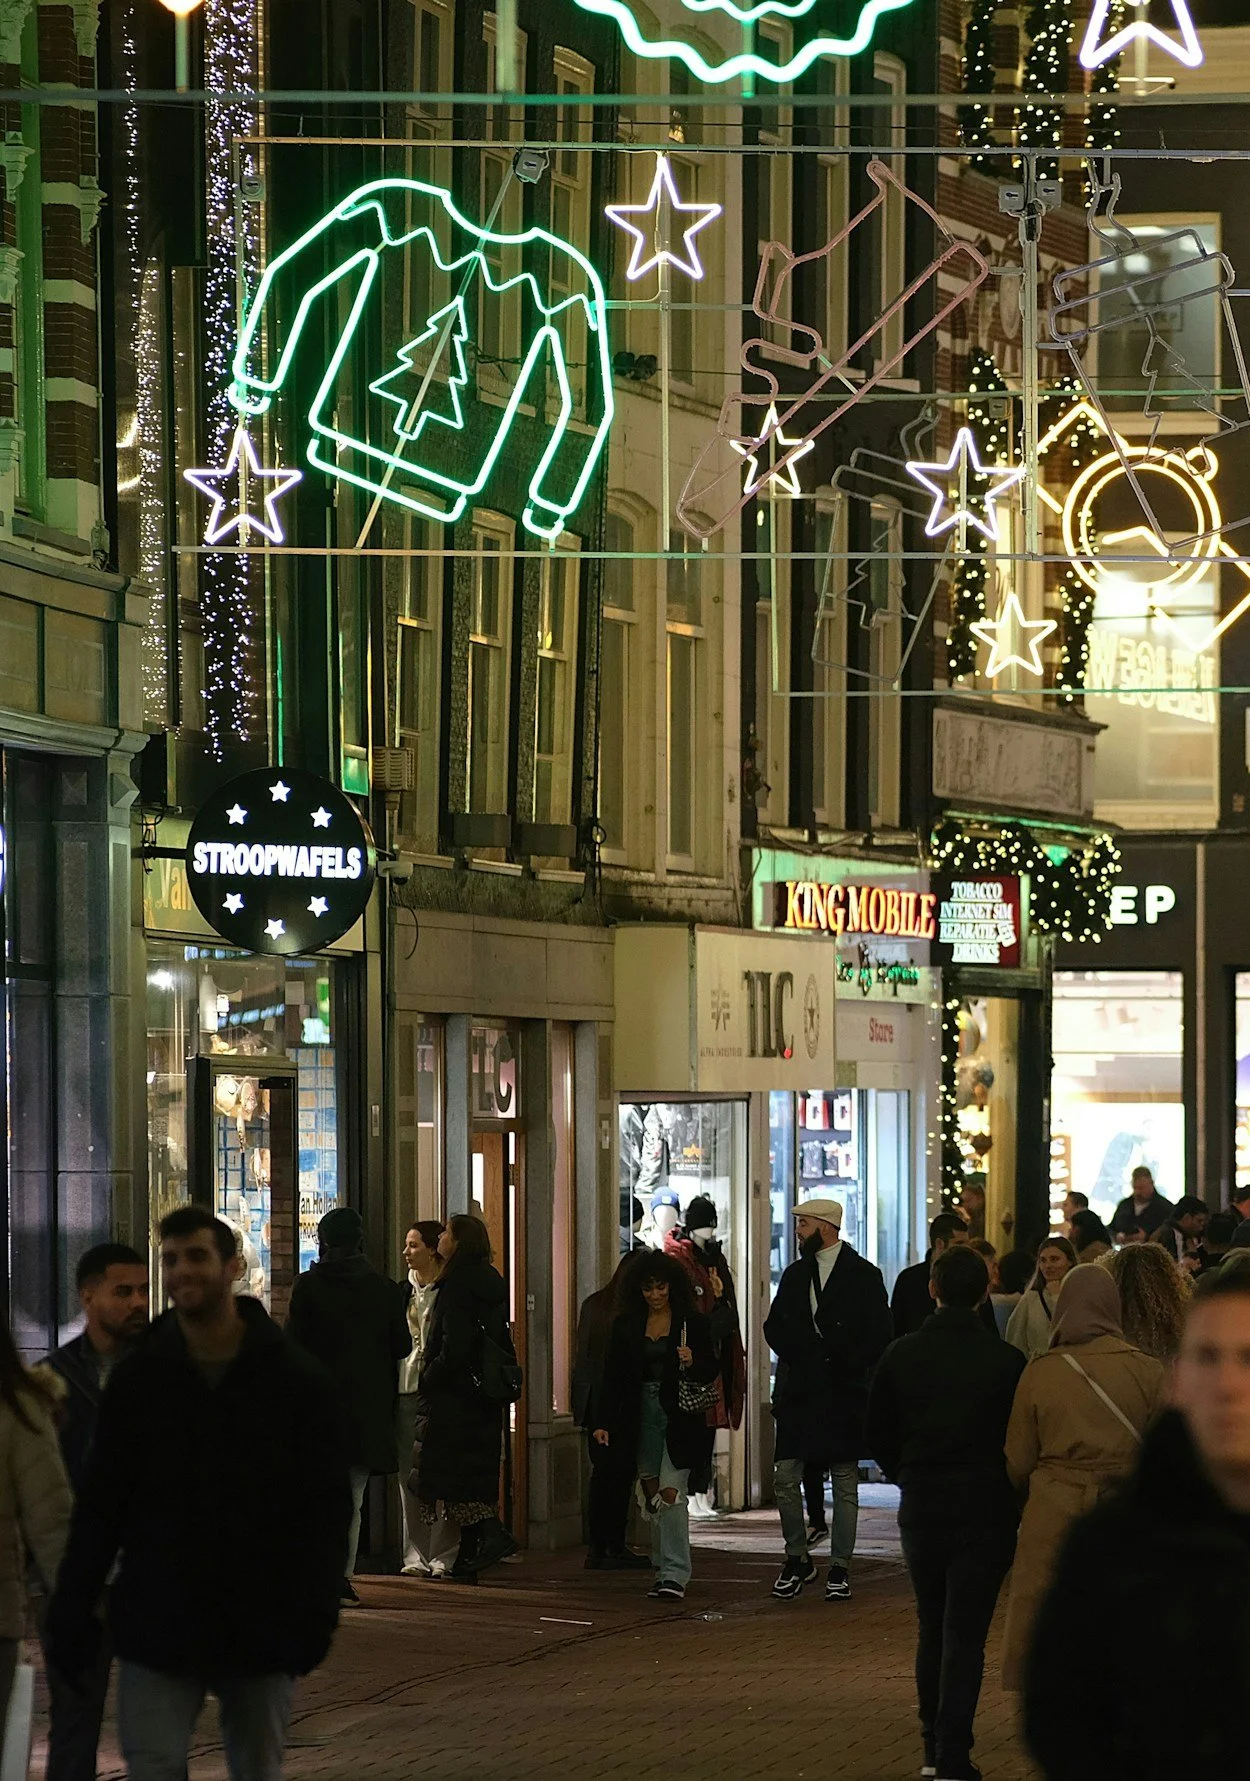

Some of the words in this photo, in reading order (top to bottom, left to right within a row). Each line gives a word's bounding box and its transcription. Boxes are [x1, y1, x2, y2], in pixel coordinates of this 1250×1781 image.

[192, 842, 362, 880] STROOPWAFELS
[951, 881, 1004, 899] TOBACCO
[785, 881, 845, 936] KING
[847, 885, 937, 939] MOBILE
[940, 901, 993, 919] INTERNET
[993, 903, 1014, 920] SIM
[940, 922, 997, 939] REPARATIE
[952, 943, 1000, 961] DRINKS
[868, 1016, 894, 1044] Store
